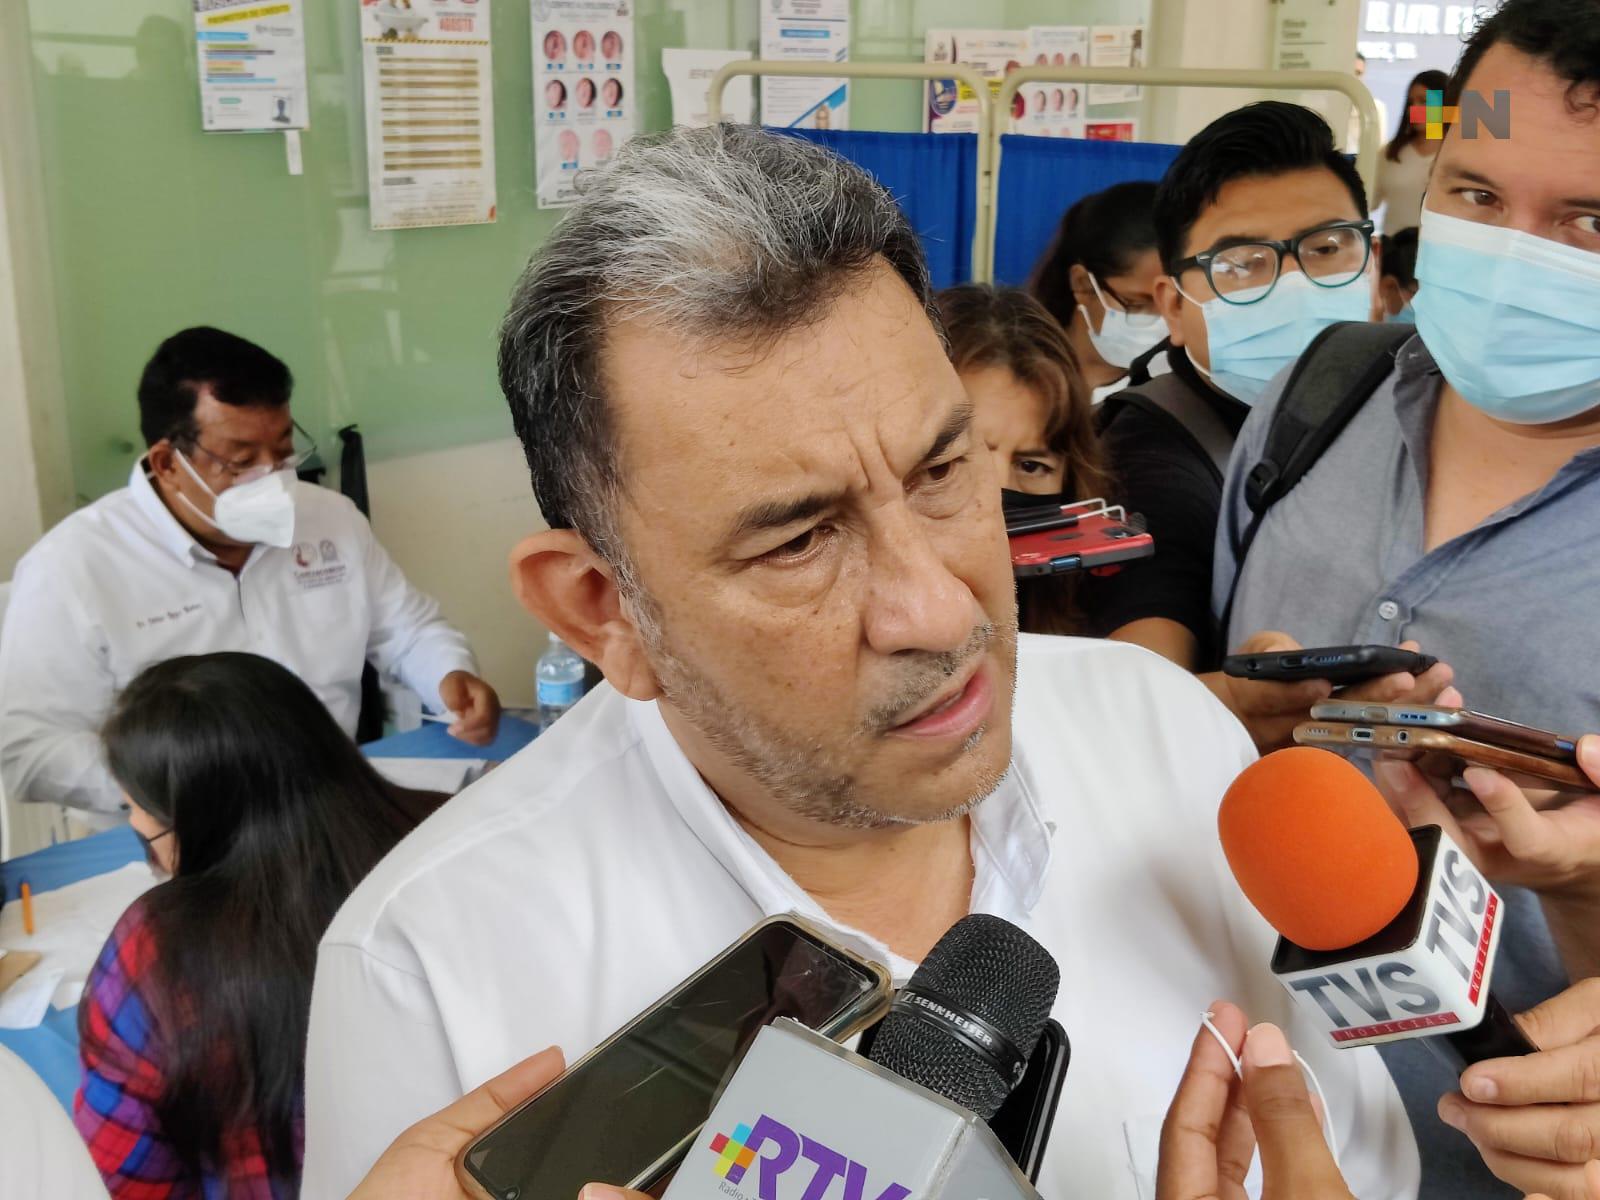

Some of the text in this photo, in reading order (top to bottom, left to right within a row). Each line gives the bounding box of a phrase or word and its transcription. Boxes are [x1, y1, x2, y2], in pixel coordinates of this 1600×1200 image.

[1425, 849, 1487, 984] TVS
[1470, 902, 1497, 992] NOTICIAS
[913, 996, 994, 1047] SENNHEISER
[1287, 961, 1440, 1028] TVS
[1343, 1014, 1449, 1040] NOTICIAS
[718, 1180, 744, 1200] Radio
